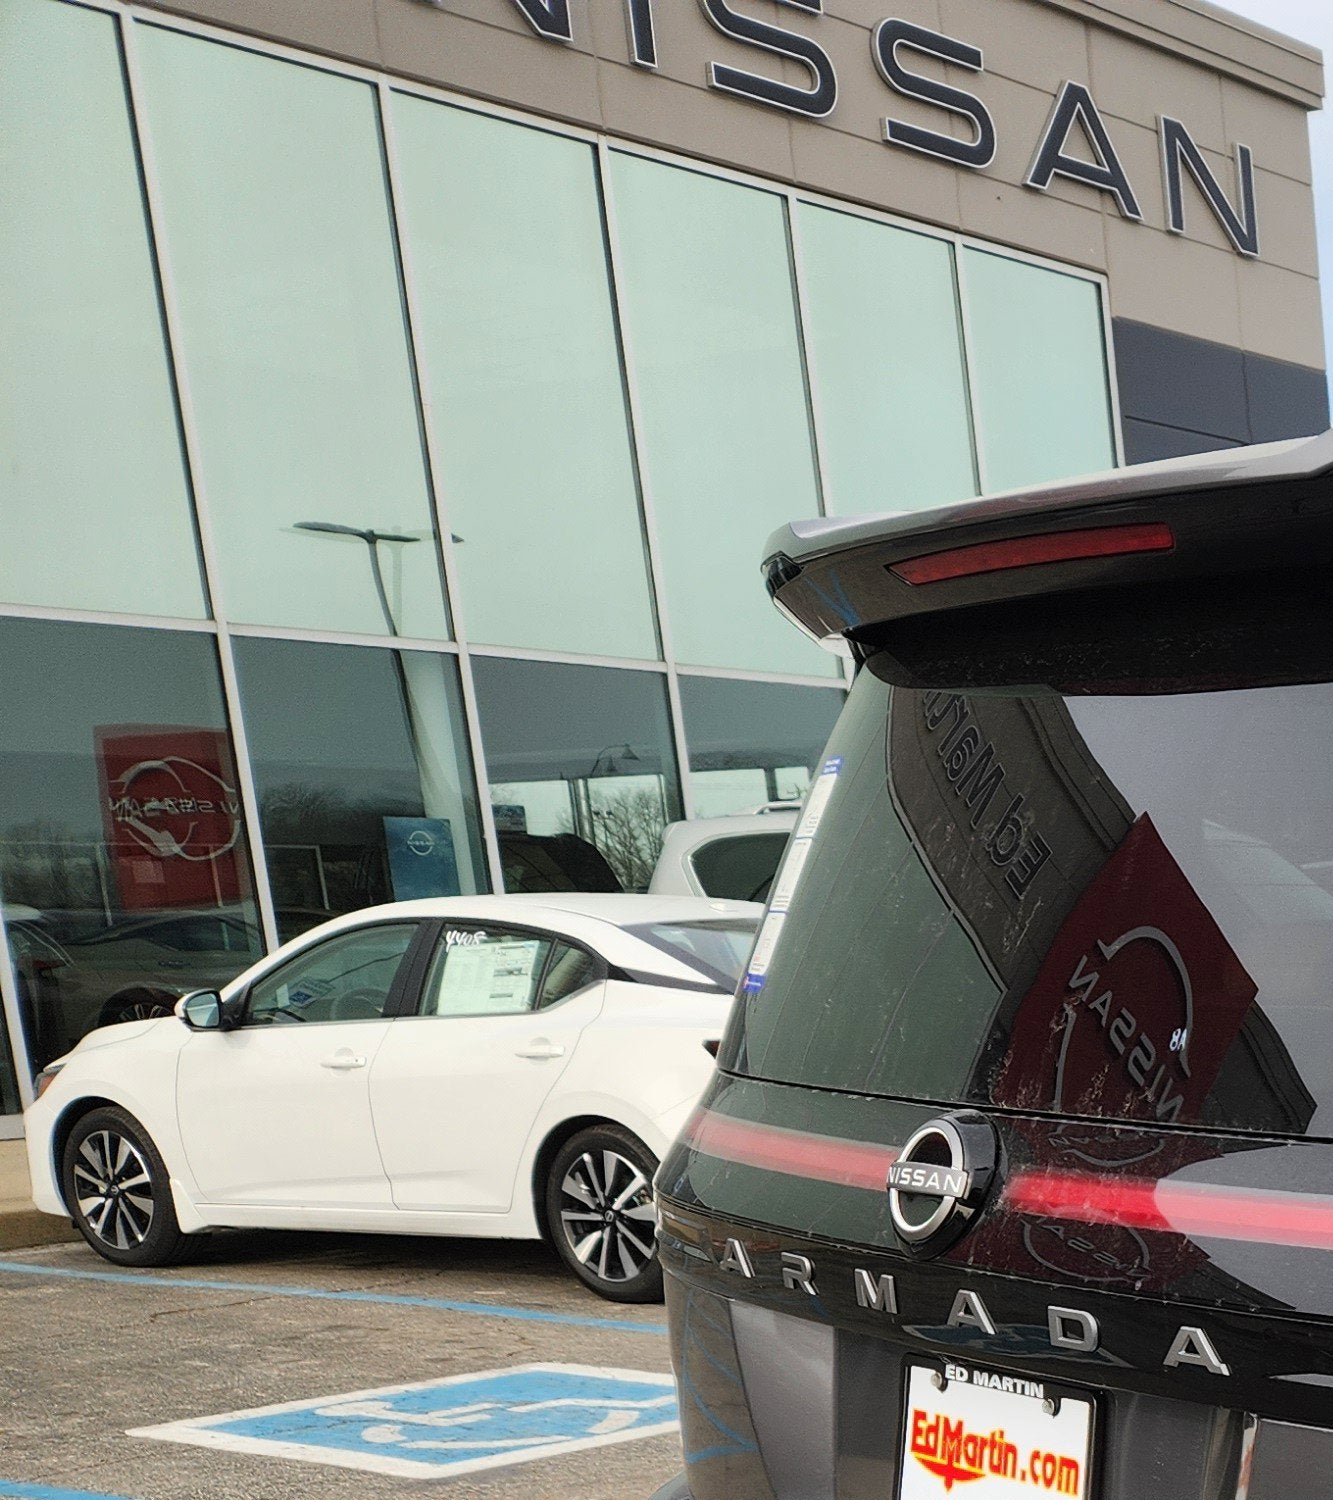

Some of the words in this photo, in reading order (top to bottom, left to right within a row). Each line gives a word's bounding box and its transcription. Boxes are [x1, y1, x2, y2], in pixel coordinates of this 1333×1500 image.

[429, 0, 1260, 258] SSAN
[888, 1165, 963, 1193] NISSAN
[720, 1237, 1231, 1376] ARMADA
[945, 1364, 968, 1381] ED
[973, 1370, 1044, 1399] MARTIN
[911, 1409, 1080, 1495] EdMartin.com
